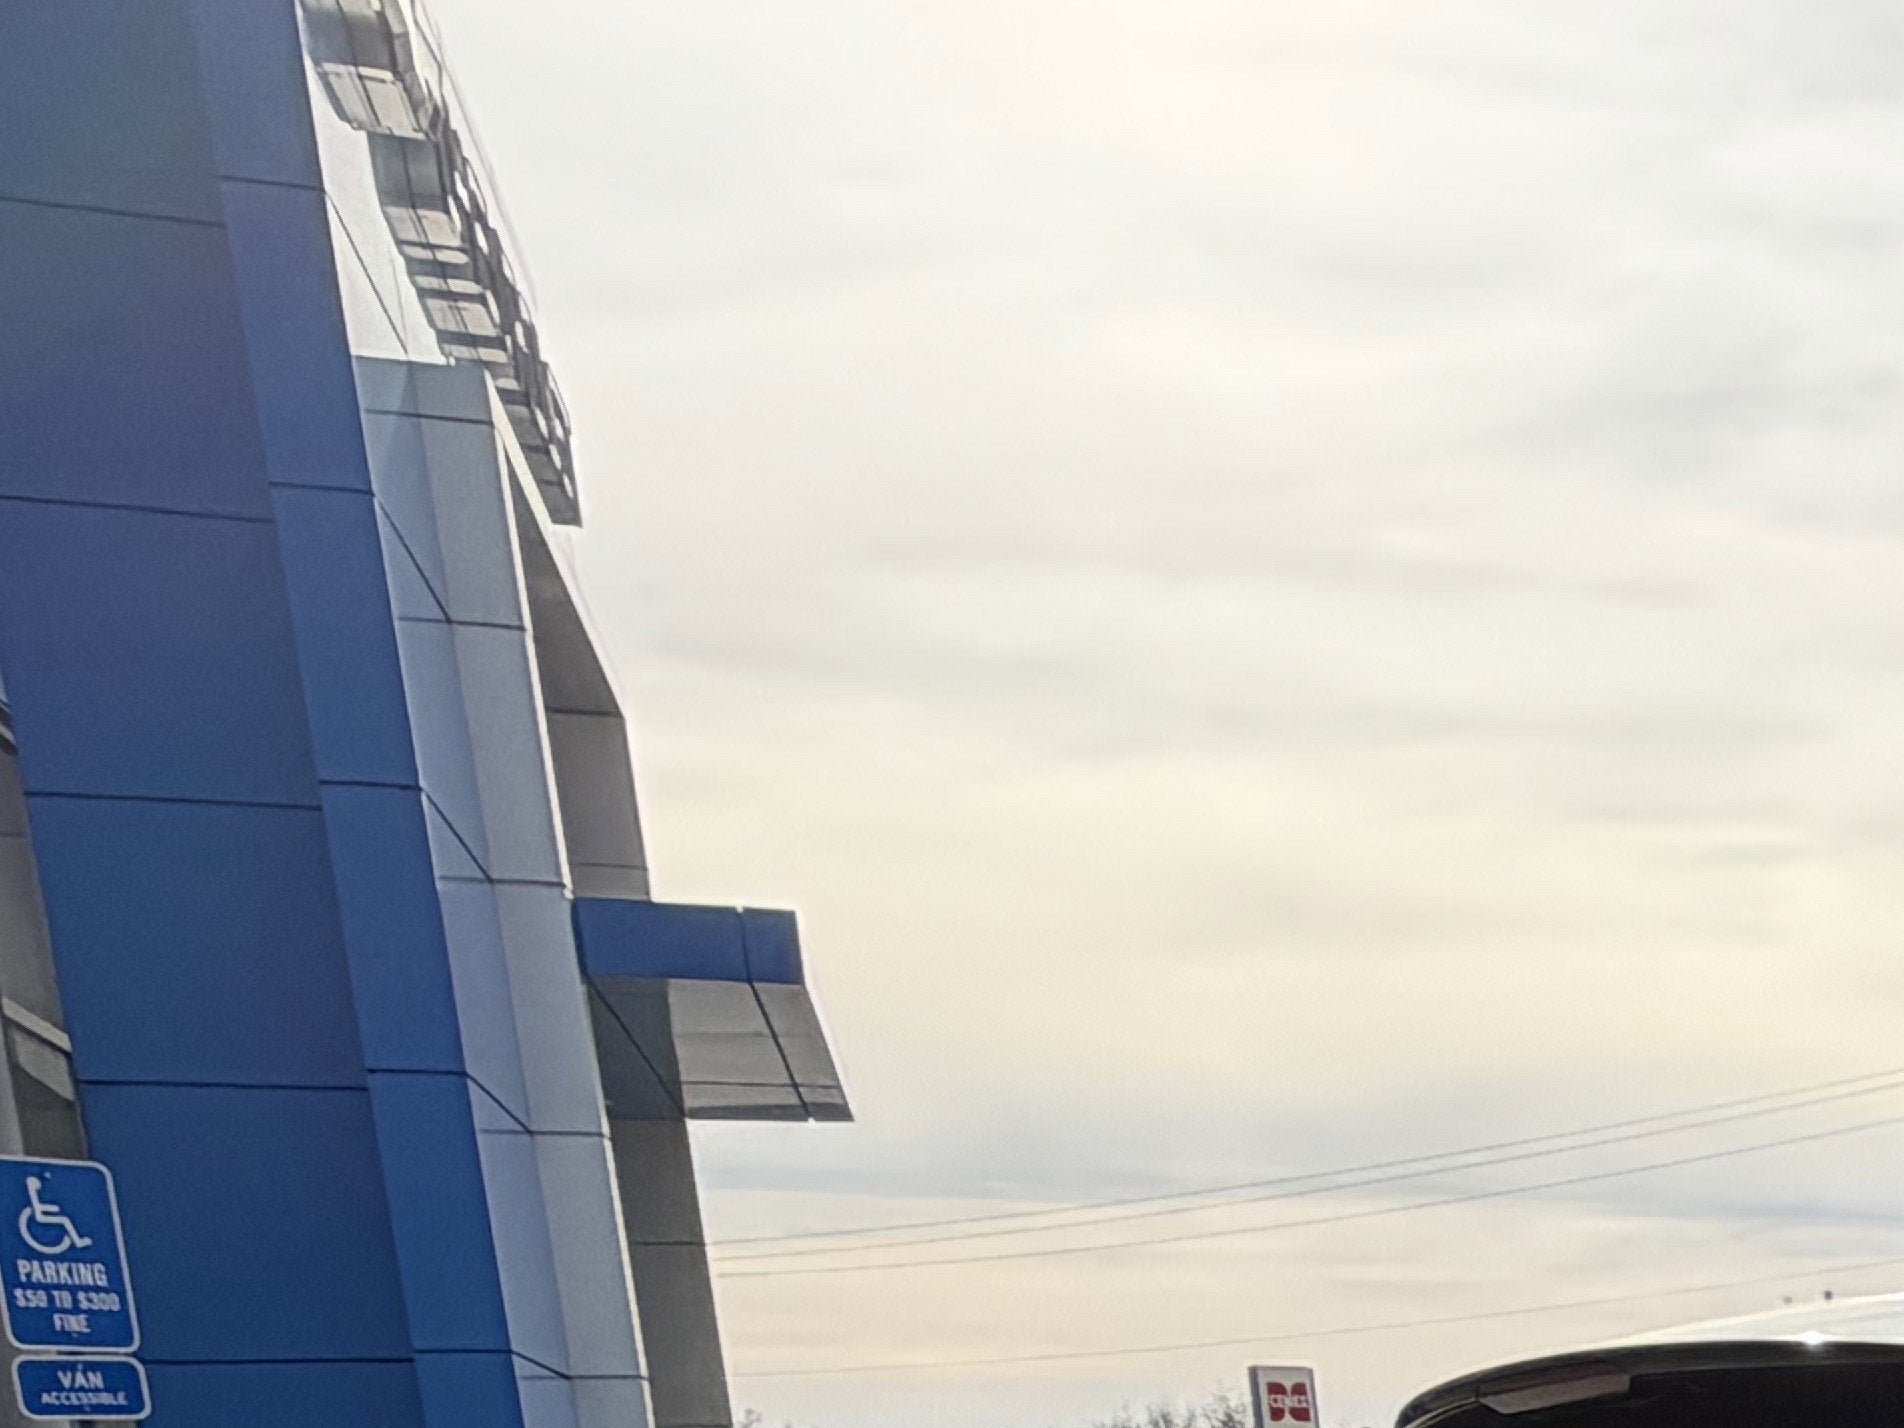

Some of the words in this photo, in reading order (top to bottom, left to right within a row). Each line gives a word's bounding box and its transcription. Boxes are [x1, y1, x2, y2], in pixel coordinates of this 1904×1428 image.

[16, 1258, 108, 1287] PARKING
[12, 1288, 48, 1308] $50
[52, 1290, 73, 1309] TO
[52, 1314, 92, 1333] FINE
[57, 1369, 104, 1388] VAN
